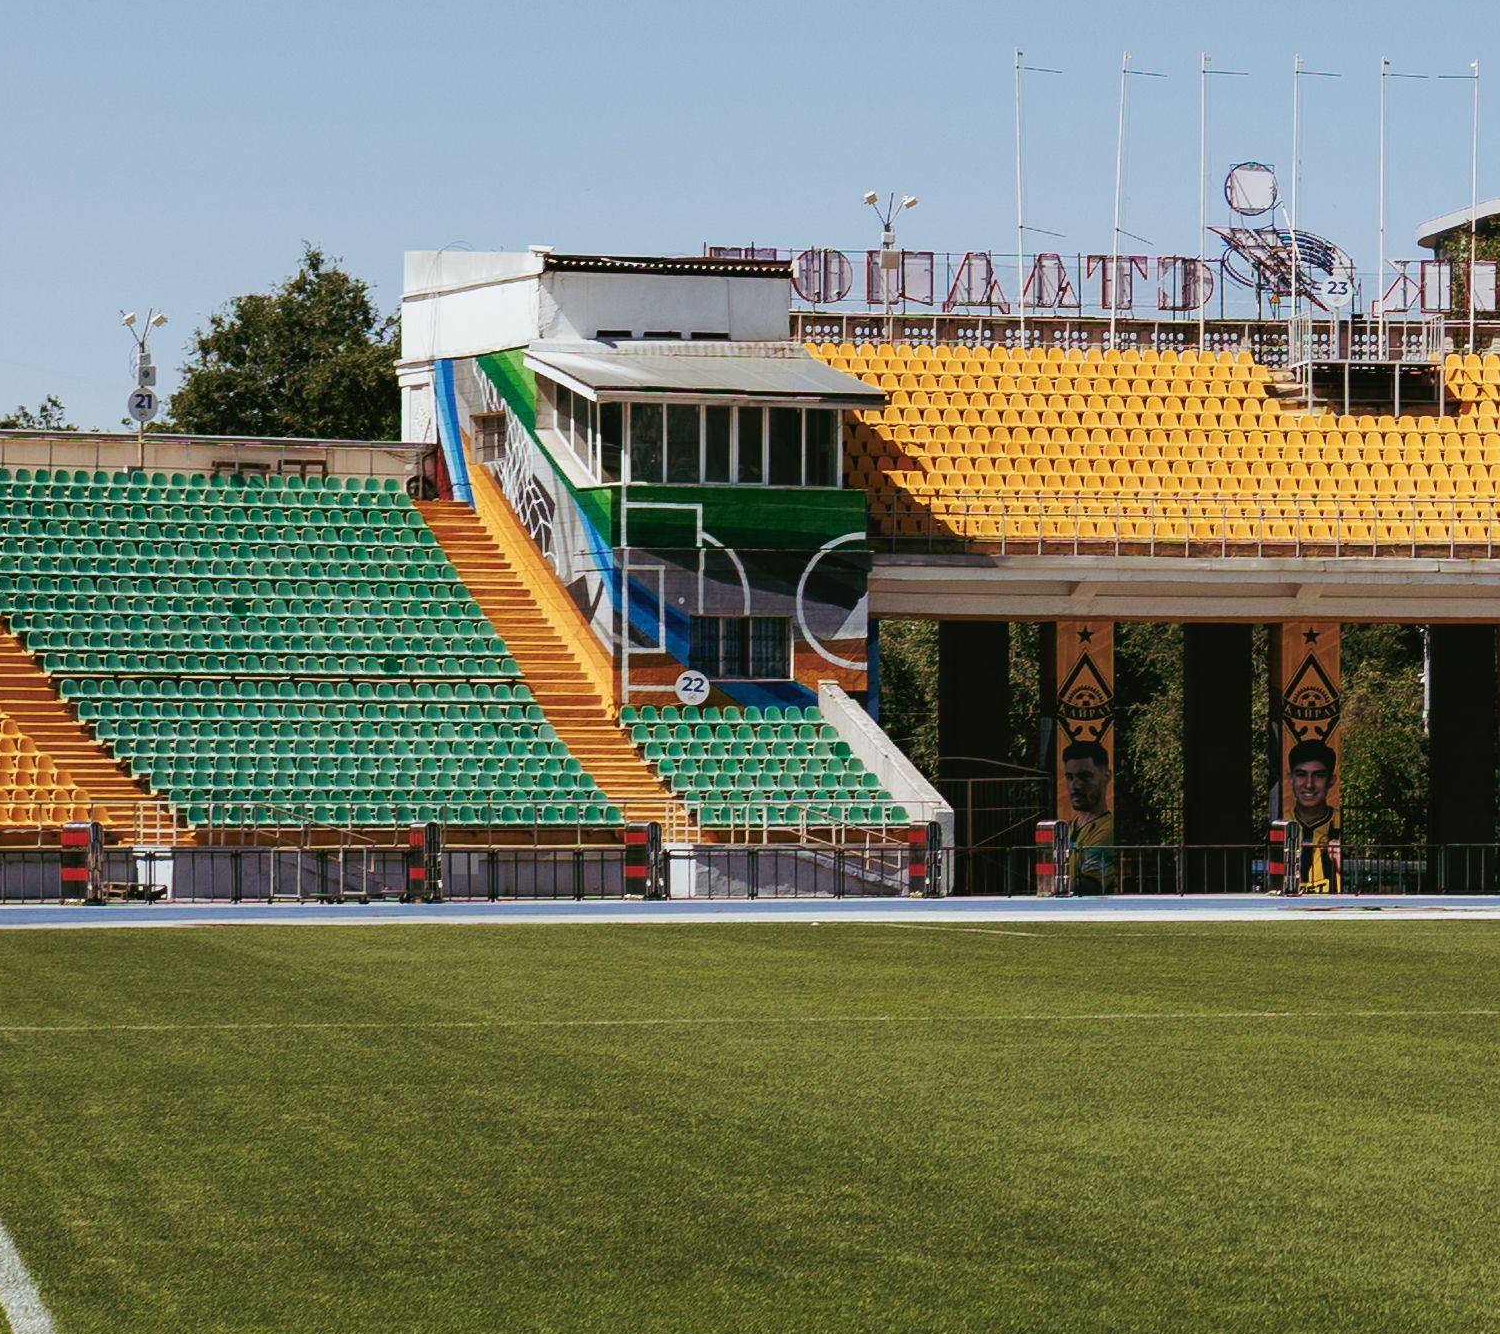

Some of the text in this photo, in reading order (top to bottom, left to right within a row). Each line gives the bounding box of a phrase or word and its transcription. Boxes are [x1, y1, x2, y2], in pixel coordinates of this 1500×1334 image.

[1326, 281, 1348, 295] 23
[134, 393, 153, 410] 21
[681, 676, 705, 693] 22
